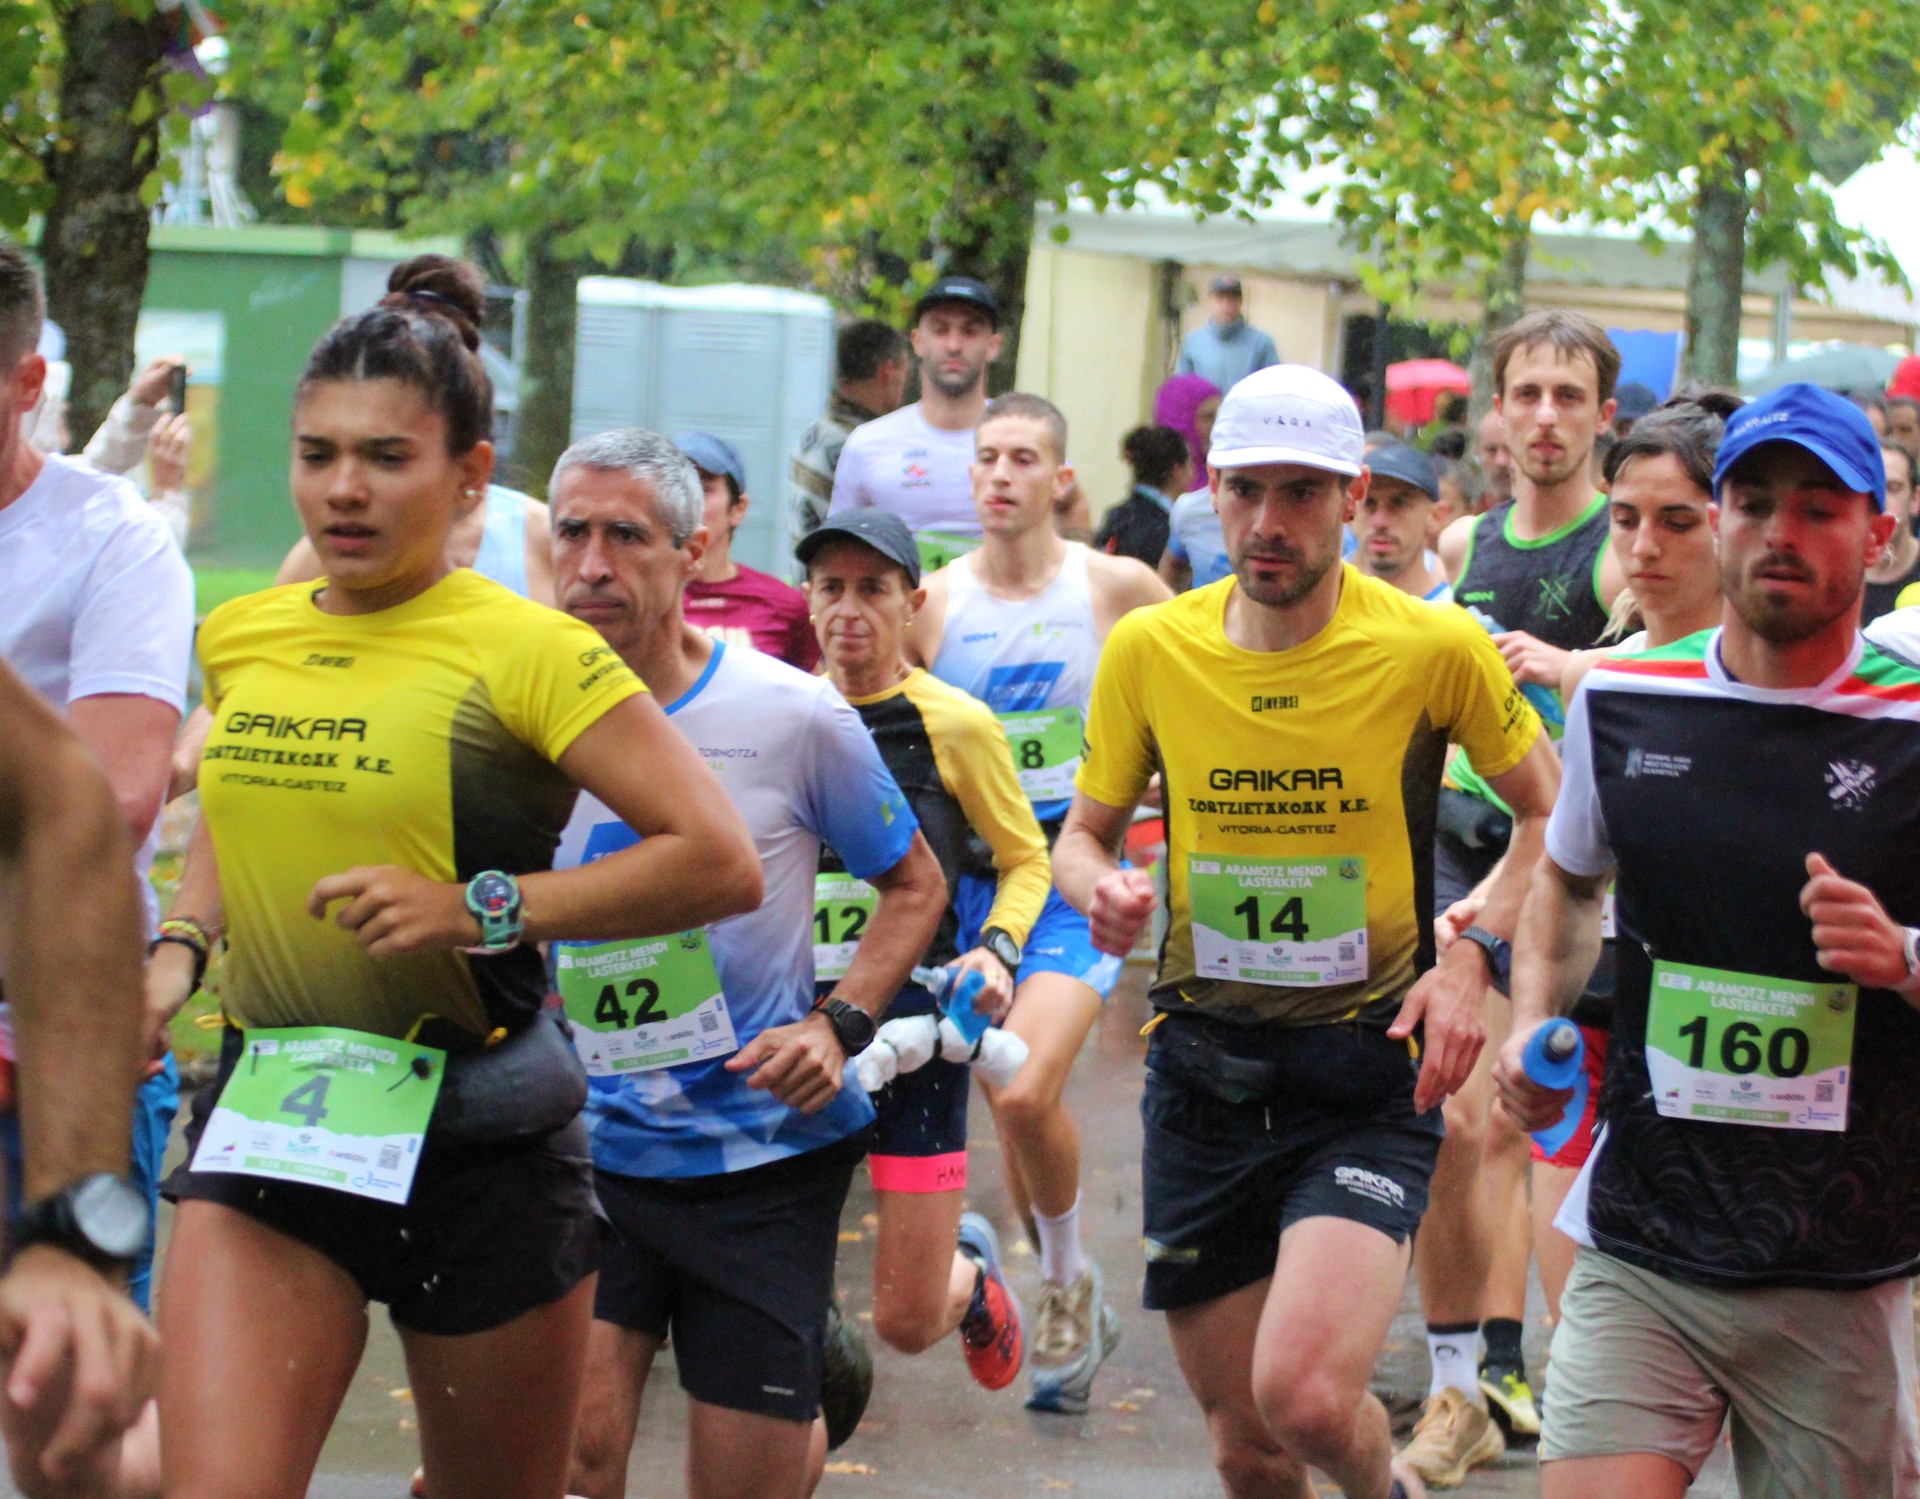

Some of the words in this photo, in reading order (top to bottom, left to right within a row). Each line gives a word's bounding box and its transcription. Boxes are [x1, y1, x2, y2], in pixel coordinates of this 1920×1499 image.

[225, 711, 367, 742] GAIKAR
[1209, 767, 1343, 792] GAIKAR
[1188, 799, 1327, 815] ZORTZIETAKOAK
[1339, 799, 1369, 813] K.E.
[1218, 824, 1337, 835] VITORIA-GASTEIZ
[1225, 864, 1285, 877] ARAMOTZ
[1287, 866, 1327, 877] MENDI
[1238, 877, 1312, 889] LASTERKETA
[814, 906, 868, 943] 12
[1234, 895, 1309, 942] 14
[594, 977, 669, 1030] 42
[1696, 979, 1766, 999] ARAMOTZ
[1769, 989, 1816, 1007] MENDI
[1710, 995, 1798, 1018] LASTERKETA
[1678, 1015, 1810, 1079] 160
[280, 1075, 332, 1128] 4
